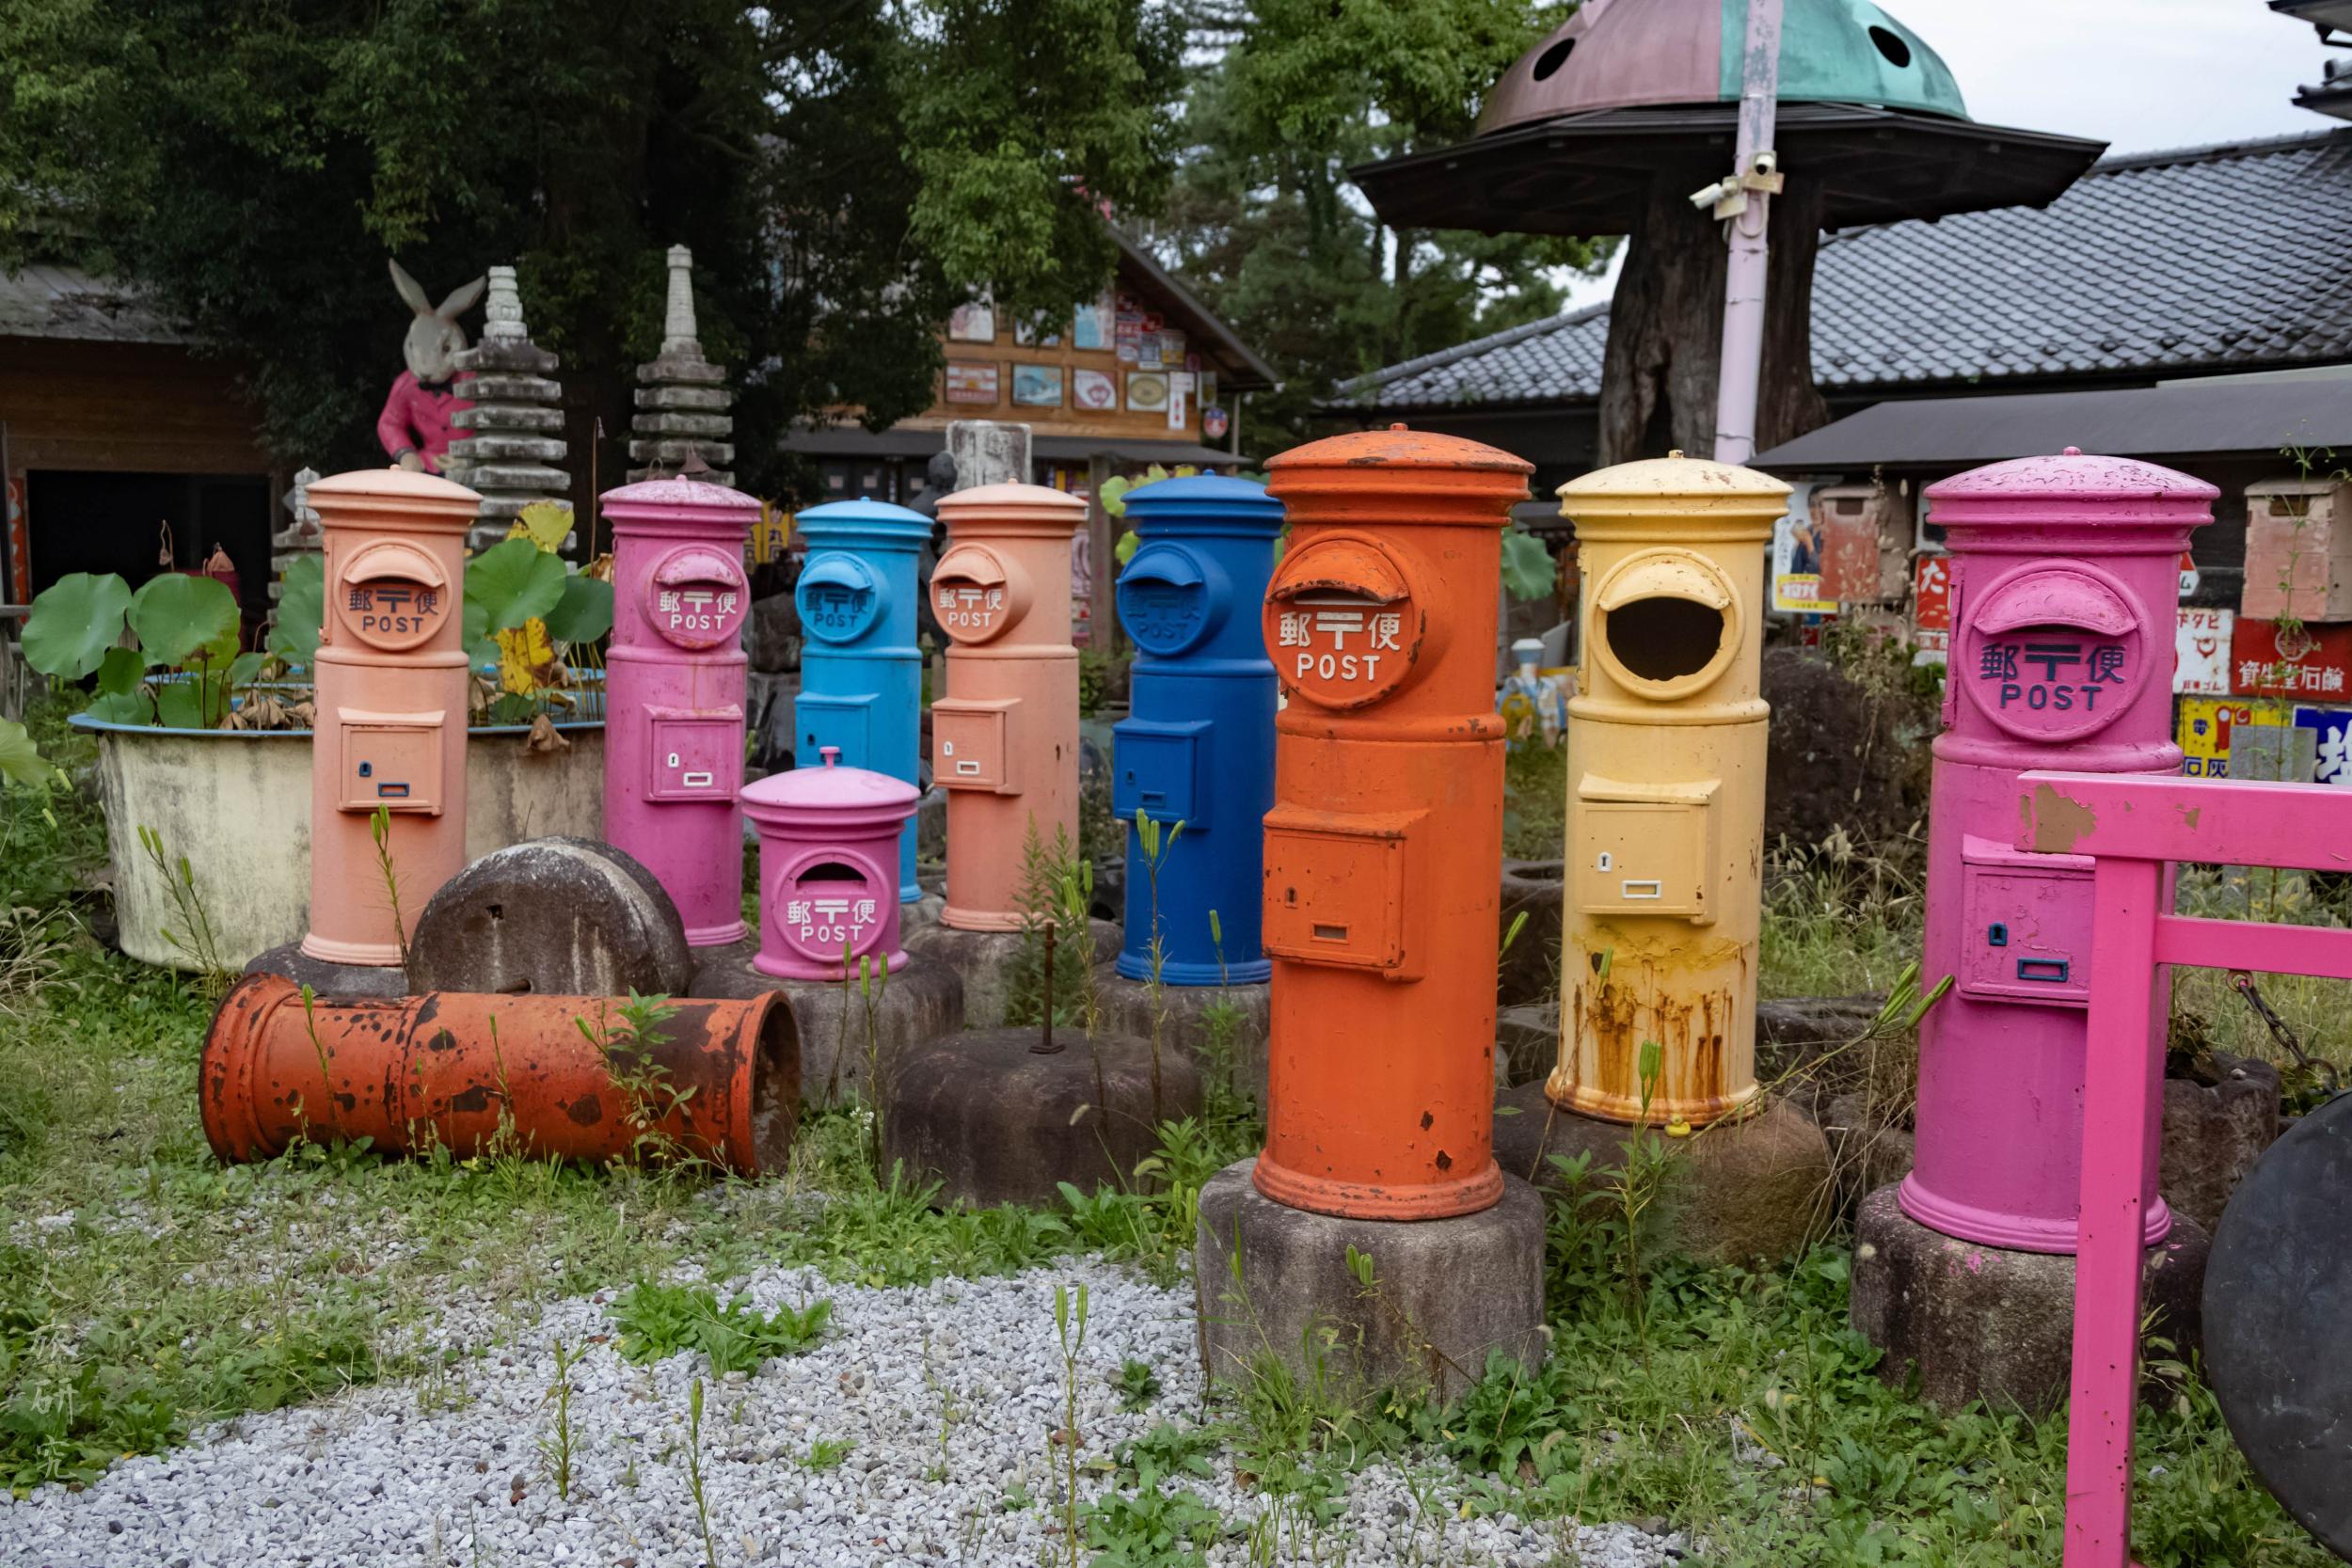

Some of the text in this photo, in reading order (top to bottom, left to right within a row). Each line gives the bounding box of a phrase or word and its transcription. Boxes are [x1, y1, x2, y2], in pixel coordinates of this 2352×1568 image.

[363, 616, 423, 633] POST
[670, 614, 725, 630] POST
[814, 613, 858, 627] POST
[948, 611, 992, 627] POST
[1136, 622, 1188, 640] POST
[1297, 653, 1380, 681] POST
[2000, 683, 2102, 711] POST
[801, 926, 864, 942] POST
